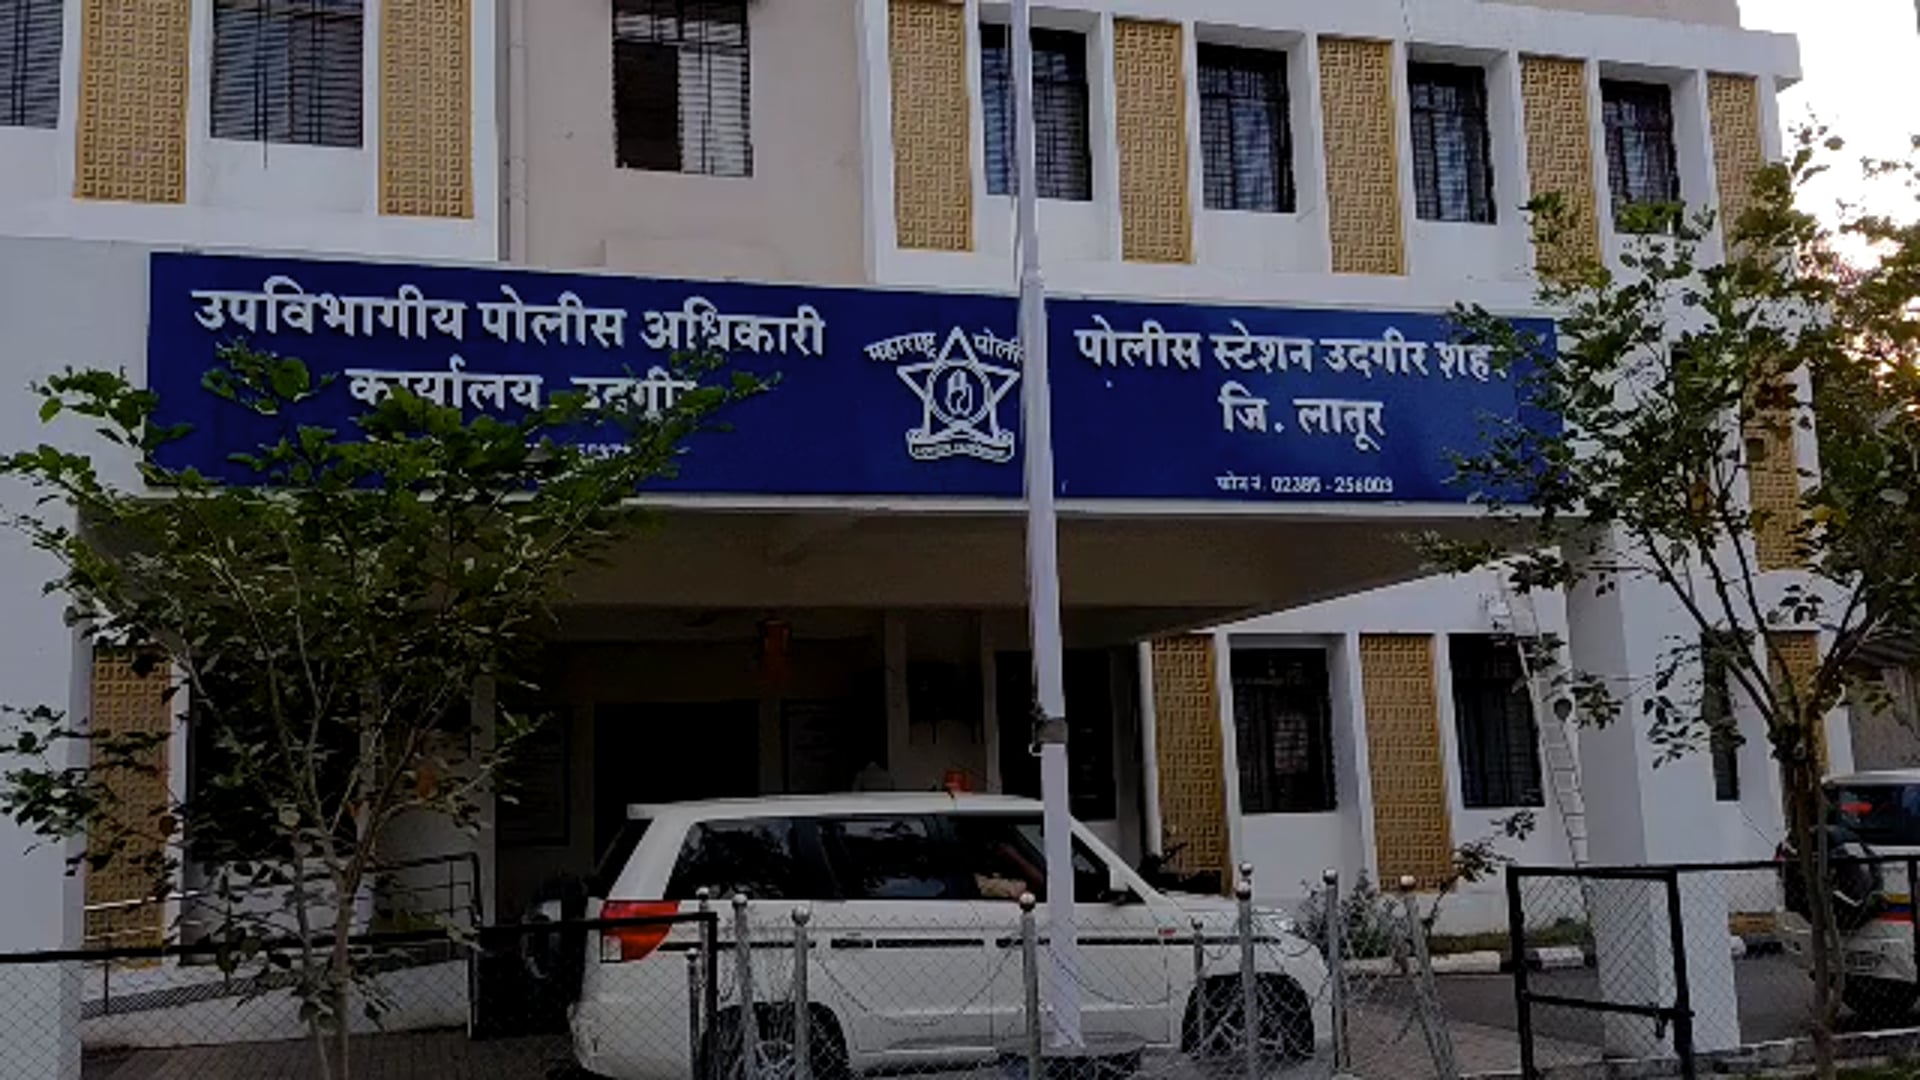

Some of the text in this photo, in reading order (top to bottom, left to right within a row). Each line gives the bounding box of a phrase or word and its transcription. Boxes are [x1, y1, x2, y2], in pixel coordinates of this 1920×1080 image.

[191, 275, 825, 355] उपविभागीय पोलीस अधिकारी
[972, 326, 1025, 366] पोली
[1073, 314, 1201, 370] पोलीस
[1208, 318, 1314, 373] स्टेशन
[1319, 326, 1428, 378] उदगीर
[1293, 397, 1385, 451] लातूर
